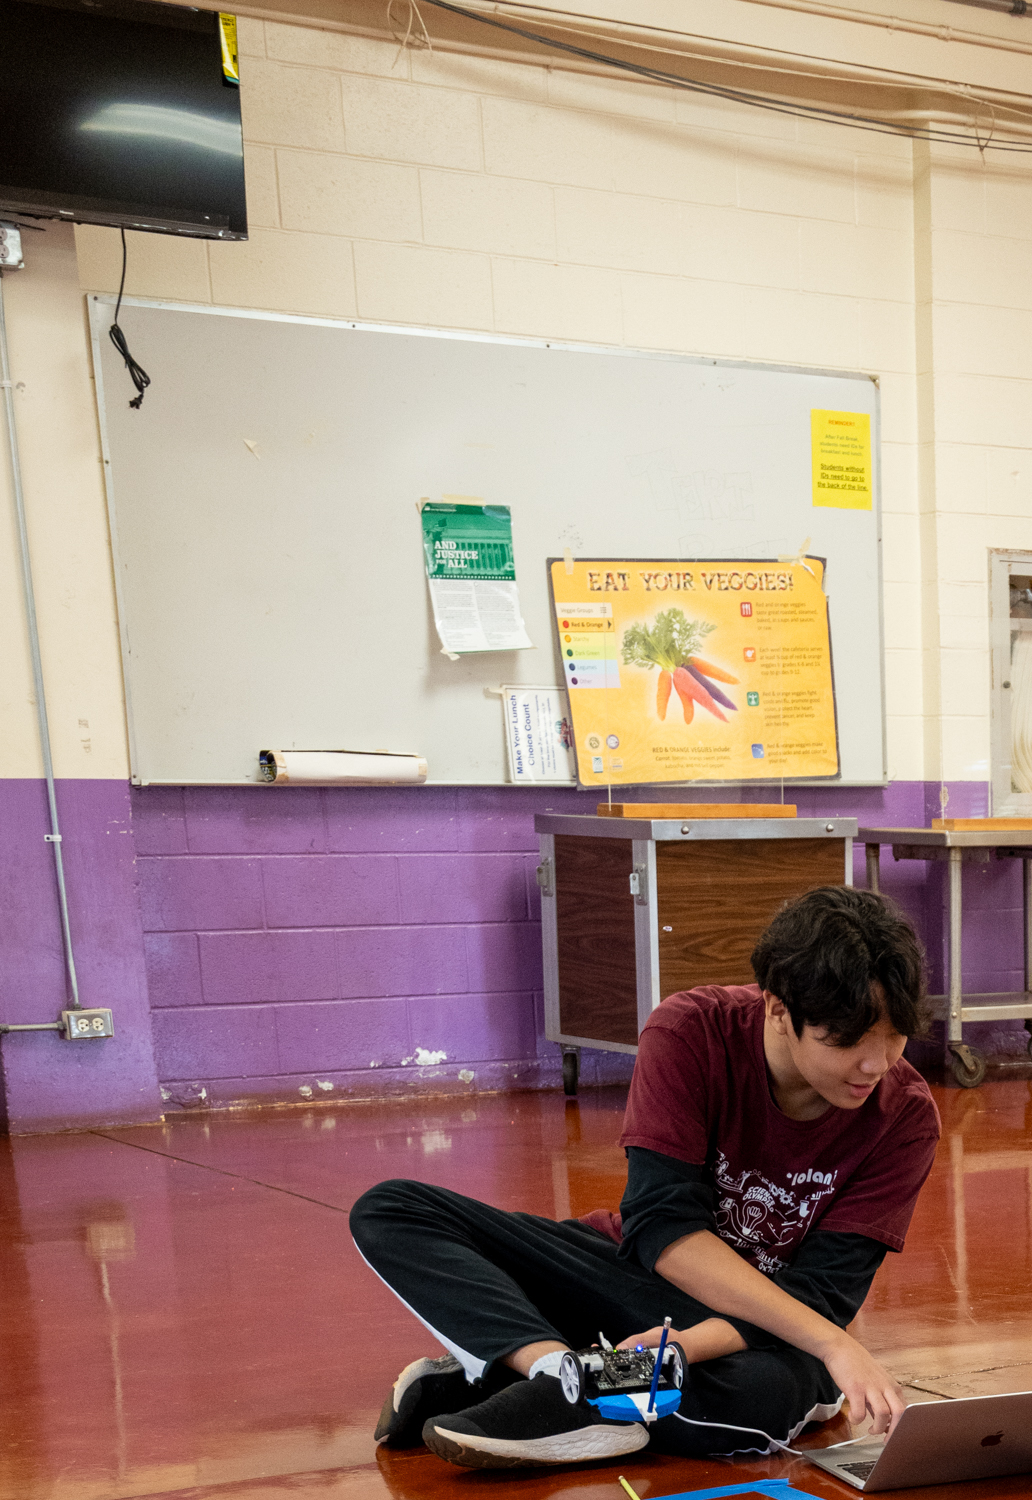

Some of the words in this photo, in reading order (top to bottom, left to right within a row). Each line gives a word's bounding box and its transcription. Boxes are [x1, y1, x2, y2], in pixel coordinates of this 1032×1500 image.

[820, 463, 844, 471] Students
[434, 541, 457, 549] AND
[435, 550, 478, 559] JUSTICE
[448, 560, 467, 568] ALL
[588, 572, 630, 592] EAT
[639, 572, 696, 592] YOUR
[700, 572, 794, 592] VEGGIES!
[510, 694, 518, 724] Lunch
[523, 703, 531, 732] Count
[527, 733, 535, 766] Choice
[516, 750, 524, 774] Make
[743, 1192, 774, 1212] OLYMPIAD
[748, 1186, 775, 1206] SCIENCE
